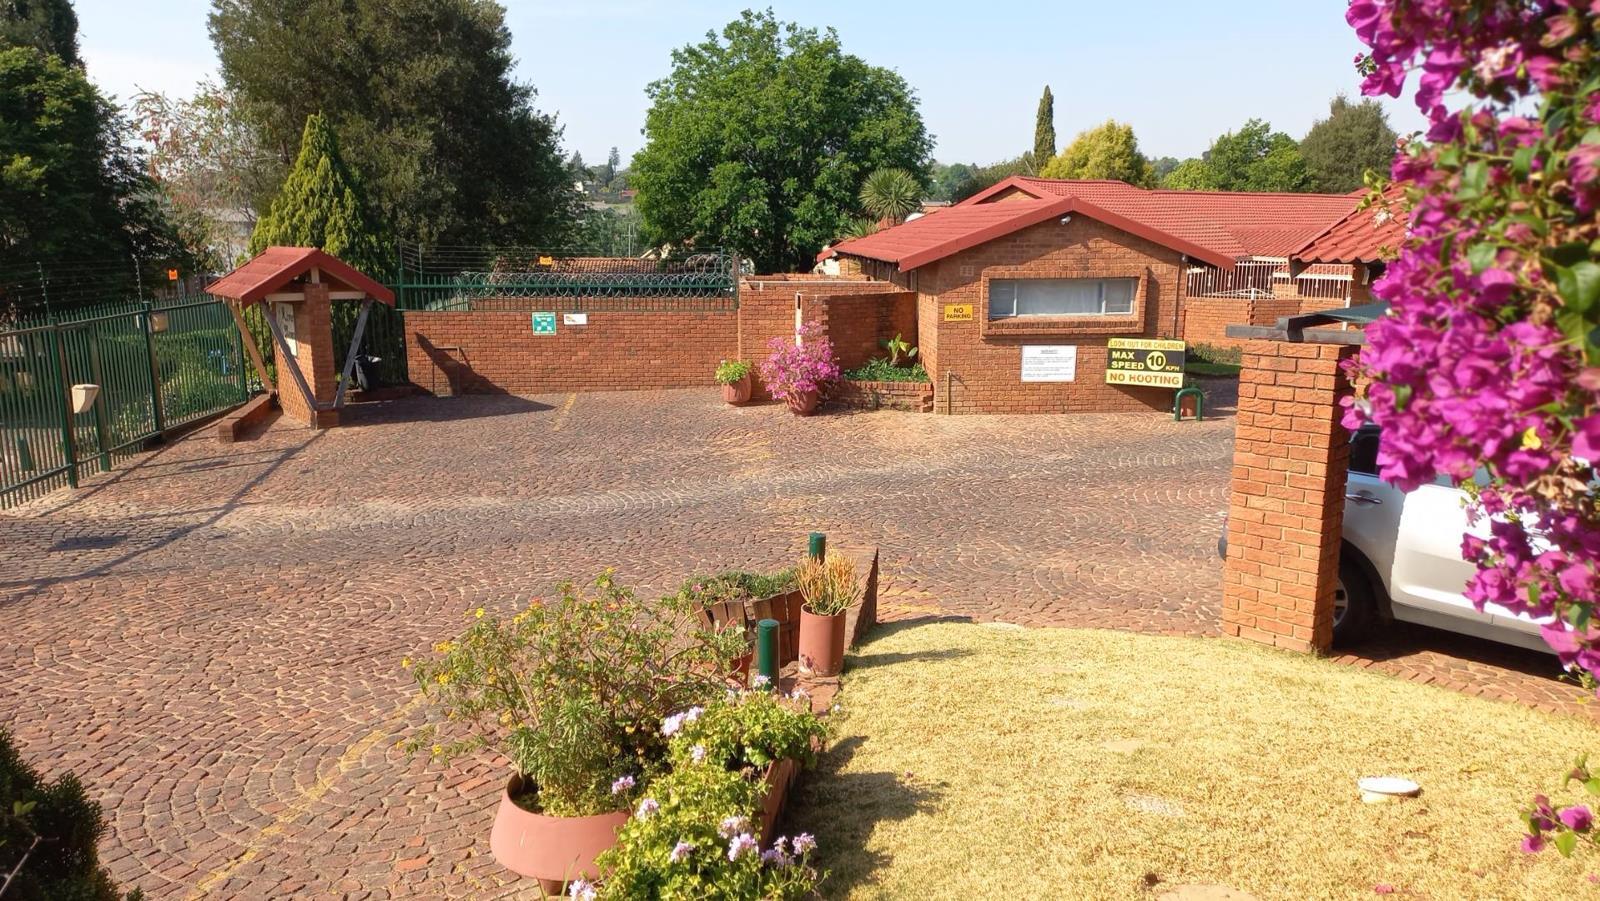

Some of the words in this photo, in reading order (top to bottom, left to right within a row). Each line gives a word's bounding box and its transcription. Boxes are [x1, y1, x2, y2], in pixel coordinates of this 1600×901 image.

[1112, 351, 1134, 359] MAX
[1111, 361, 1144, 370] SPEED
[1148, 355, 1164, 366] 10
[1110, 373, 1125, 382] NO
[1129, 374, 1180, 385] HOOTING
